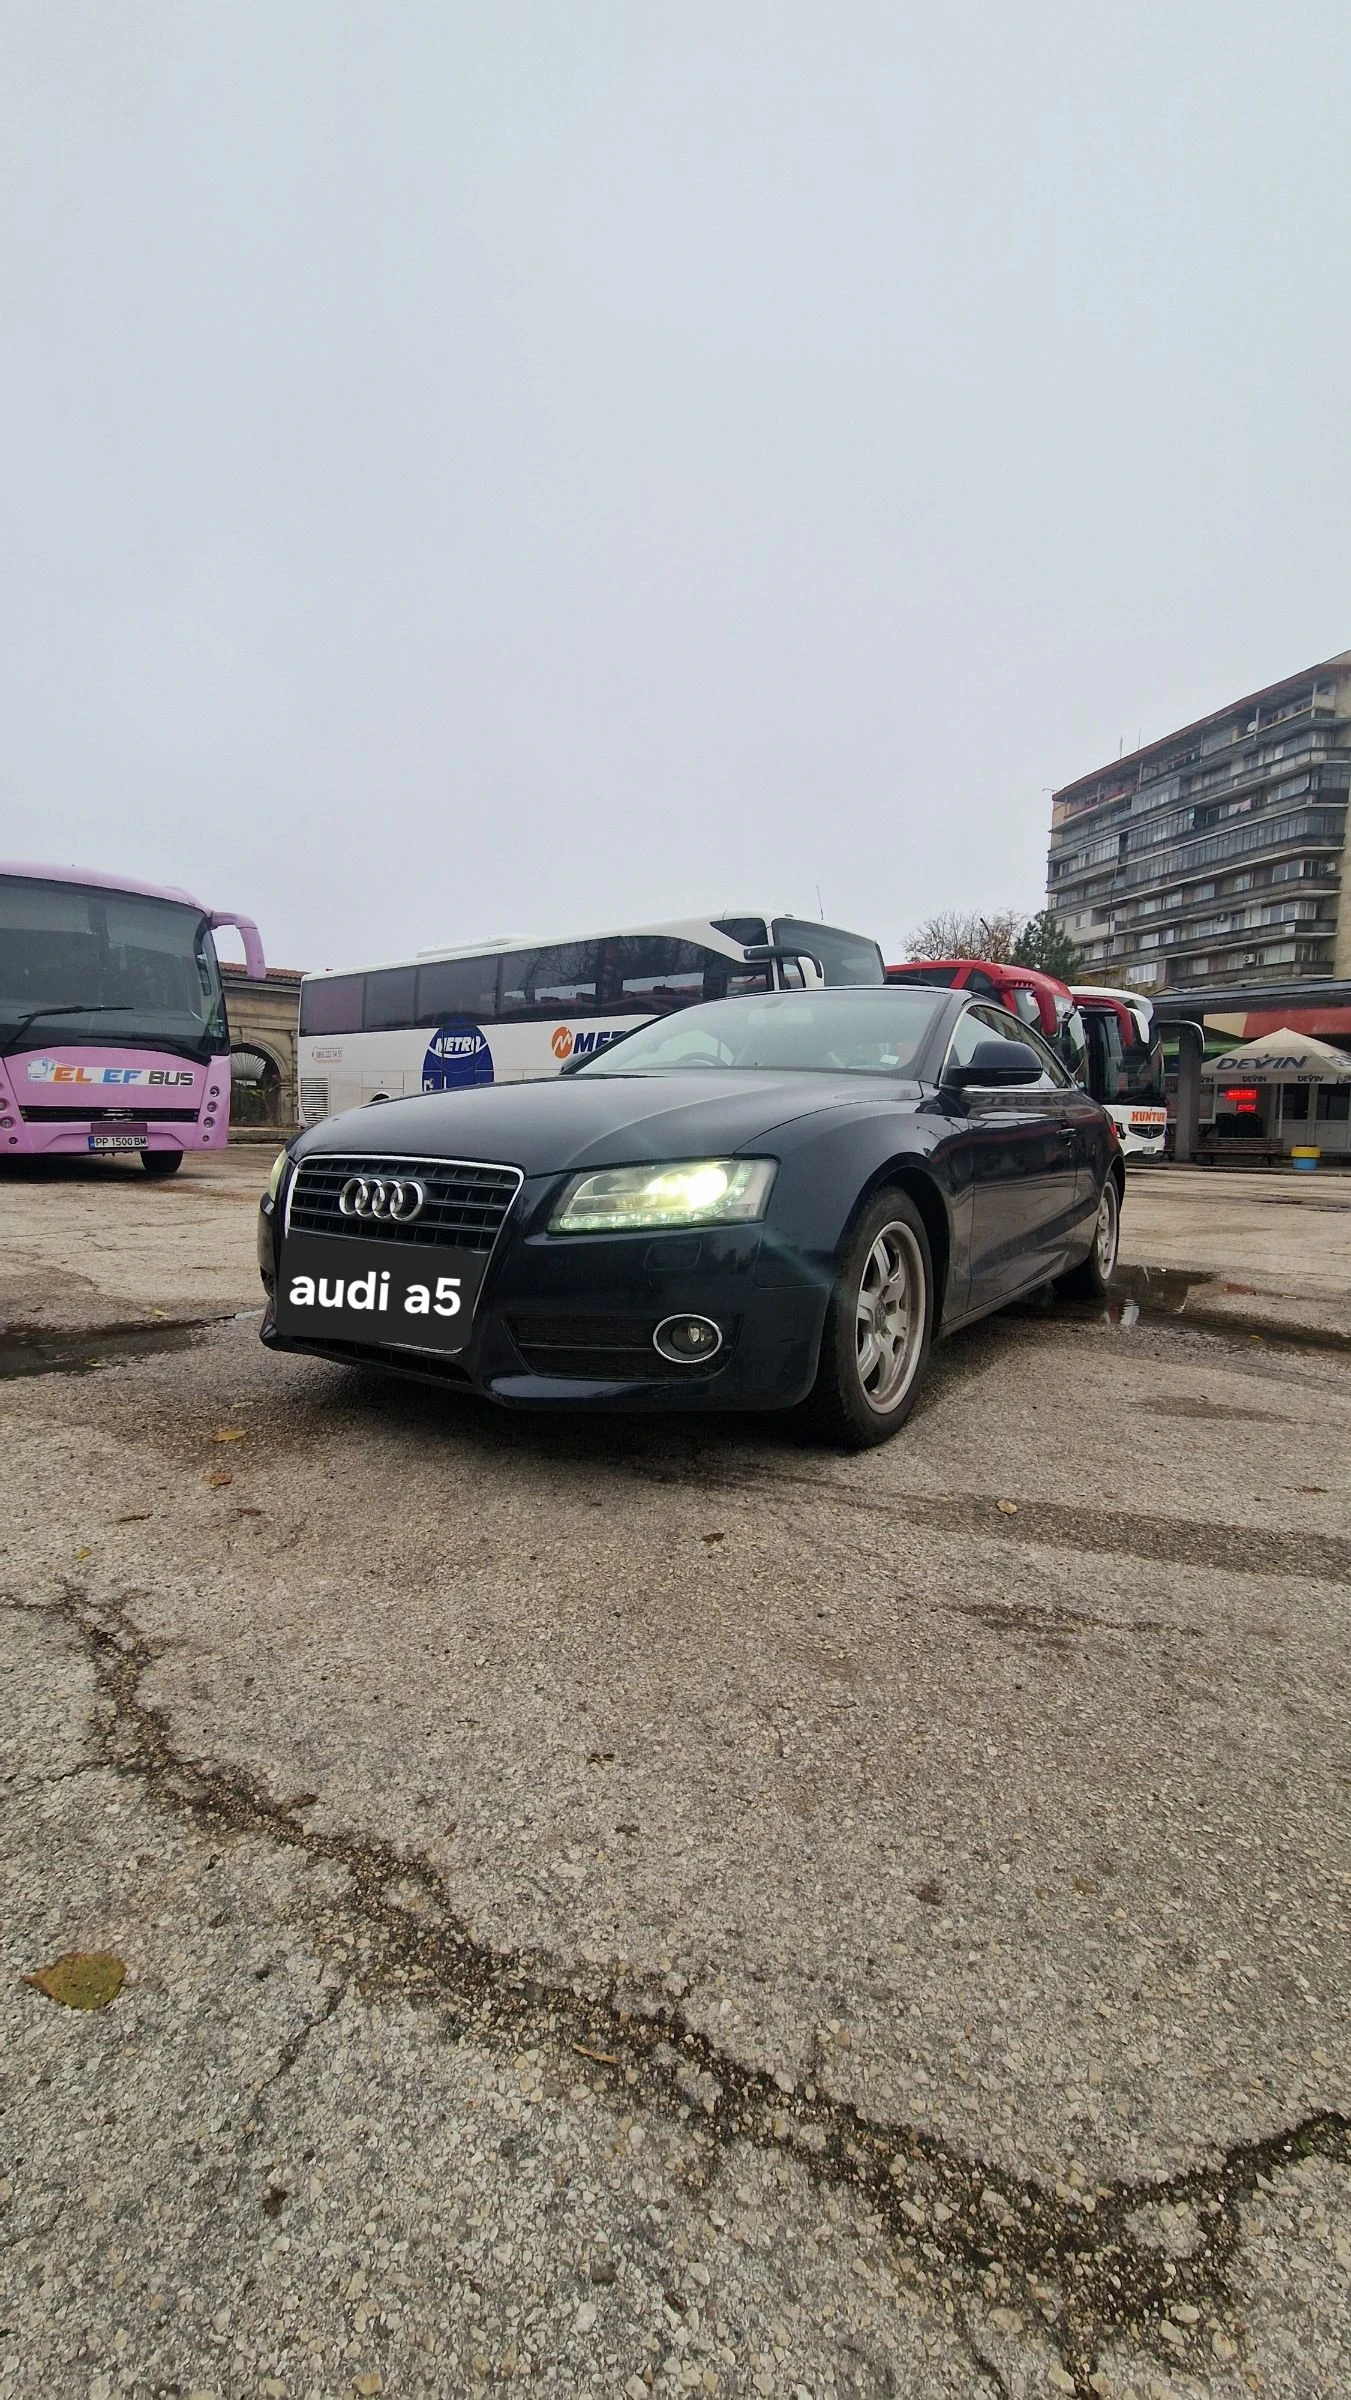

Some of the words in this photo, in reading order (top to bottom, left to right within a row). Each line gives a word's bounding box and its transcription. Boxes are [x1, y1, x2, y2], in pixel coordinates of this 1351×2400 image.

[435, 1035, 481, 1053] METRO
[1216, 1054, 1308, 1070] DEVIN
[53, 1067, 93, 1082] EL
[103, 1068, 142, 1083] EF
[148, 1071, 194, 1086] BUS
[1242, 1074, 1267, 1083] DEVIN
[1297, 1074, 1324, 1083] DEVIN
[95, 1137, 109, 1146] PP
[112, 1137, 133, 1146] 1500
[134, 1136, 147, 1146] BM
